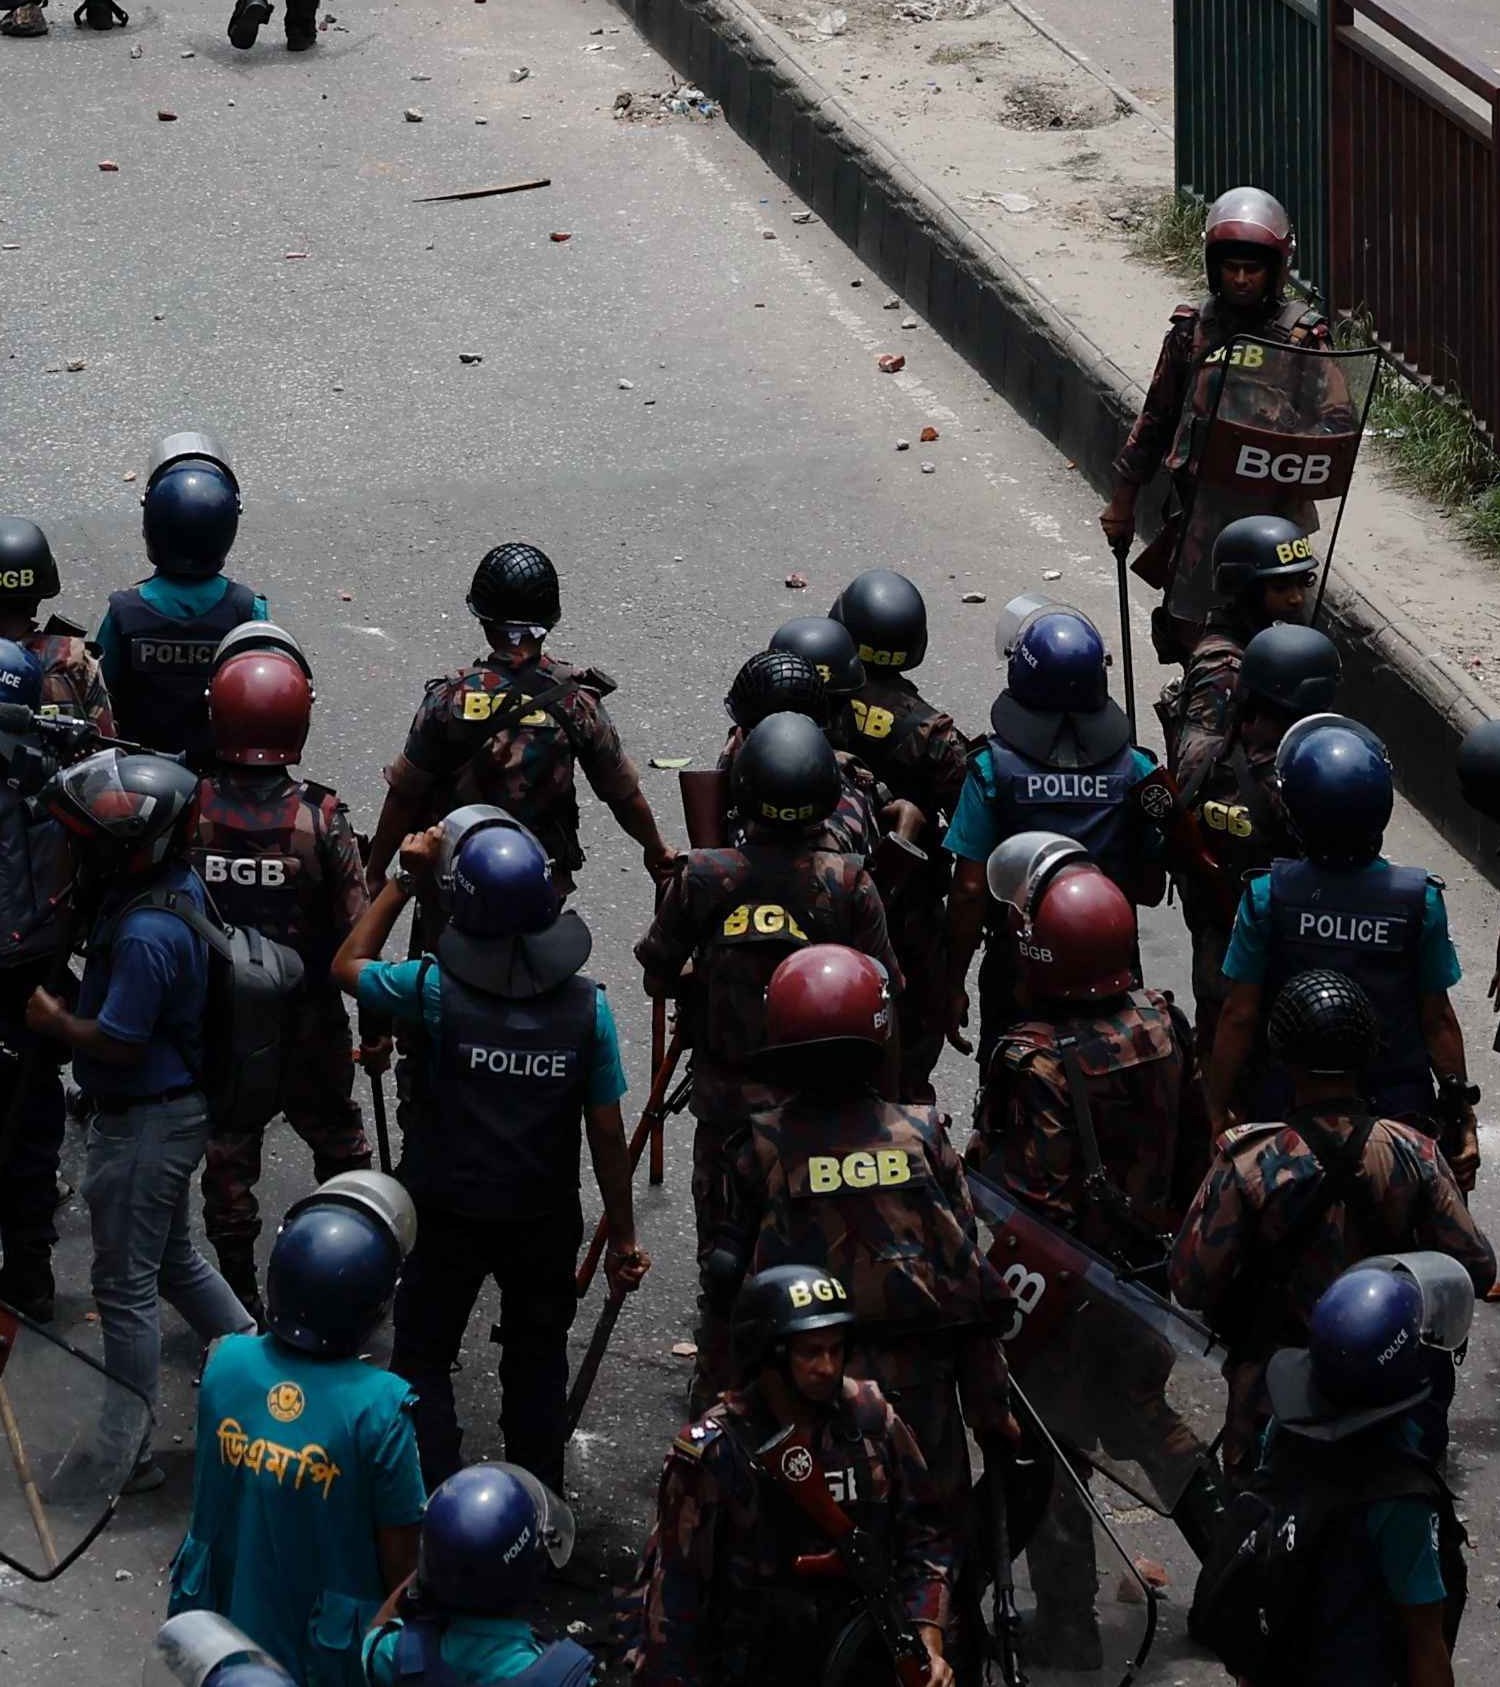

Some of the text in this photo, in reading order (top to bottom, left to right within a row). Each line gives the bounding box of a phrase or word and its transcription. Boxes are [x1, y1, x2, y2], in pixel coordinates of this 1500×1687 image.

[1235, 445, 1331, 485] BGB
[140, 643, 216, 665] POLIC
[1026, 774, 1109, 799] POLICE
[204, 856, 287, 888] BGB
[1299, 911, 1389, 945] POLICE
[1018, 941, 1053, 964] BGB
[470, 1046, 568, 1078] POLICE
[808, 1149, 912, 1193] BGB
[216, 1417, 343, 1500] ডিএমপি
